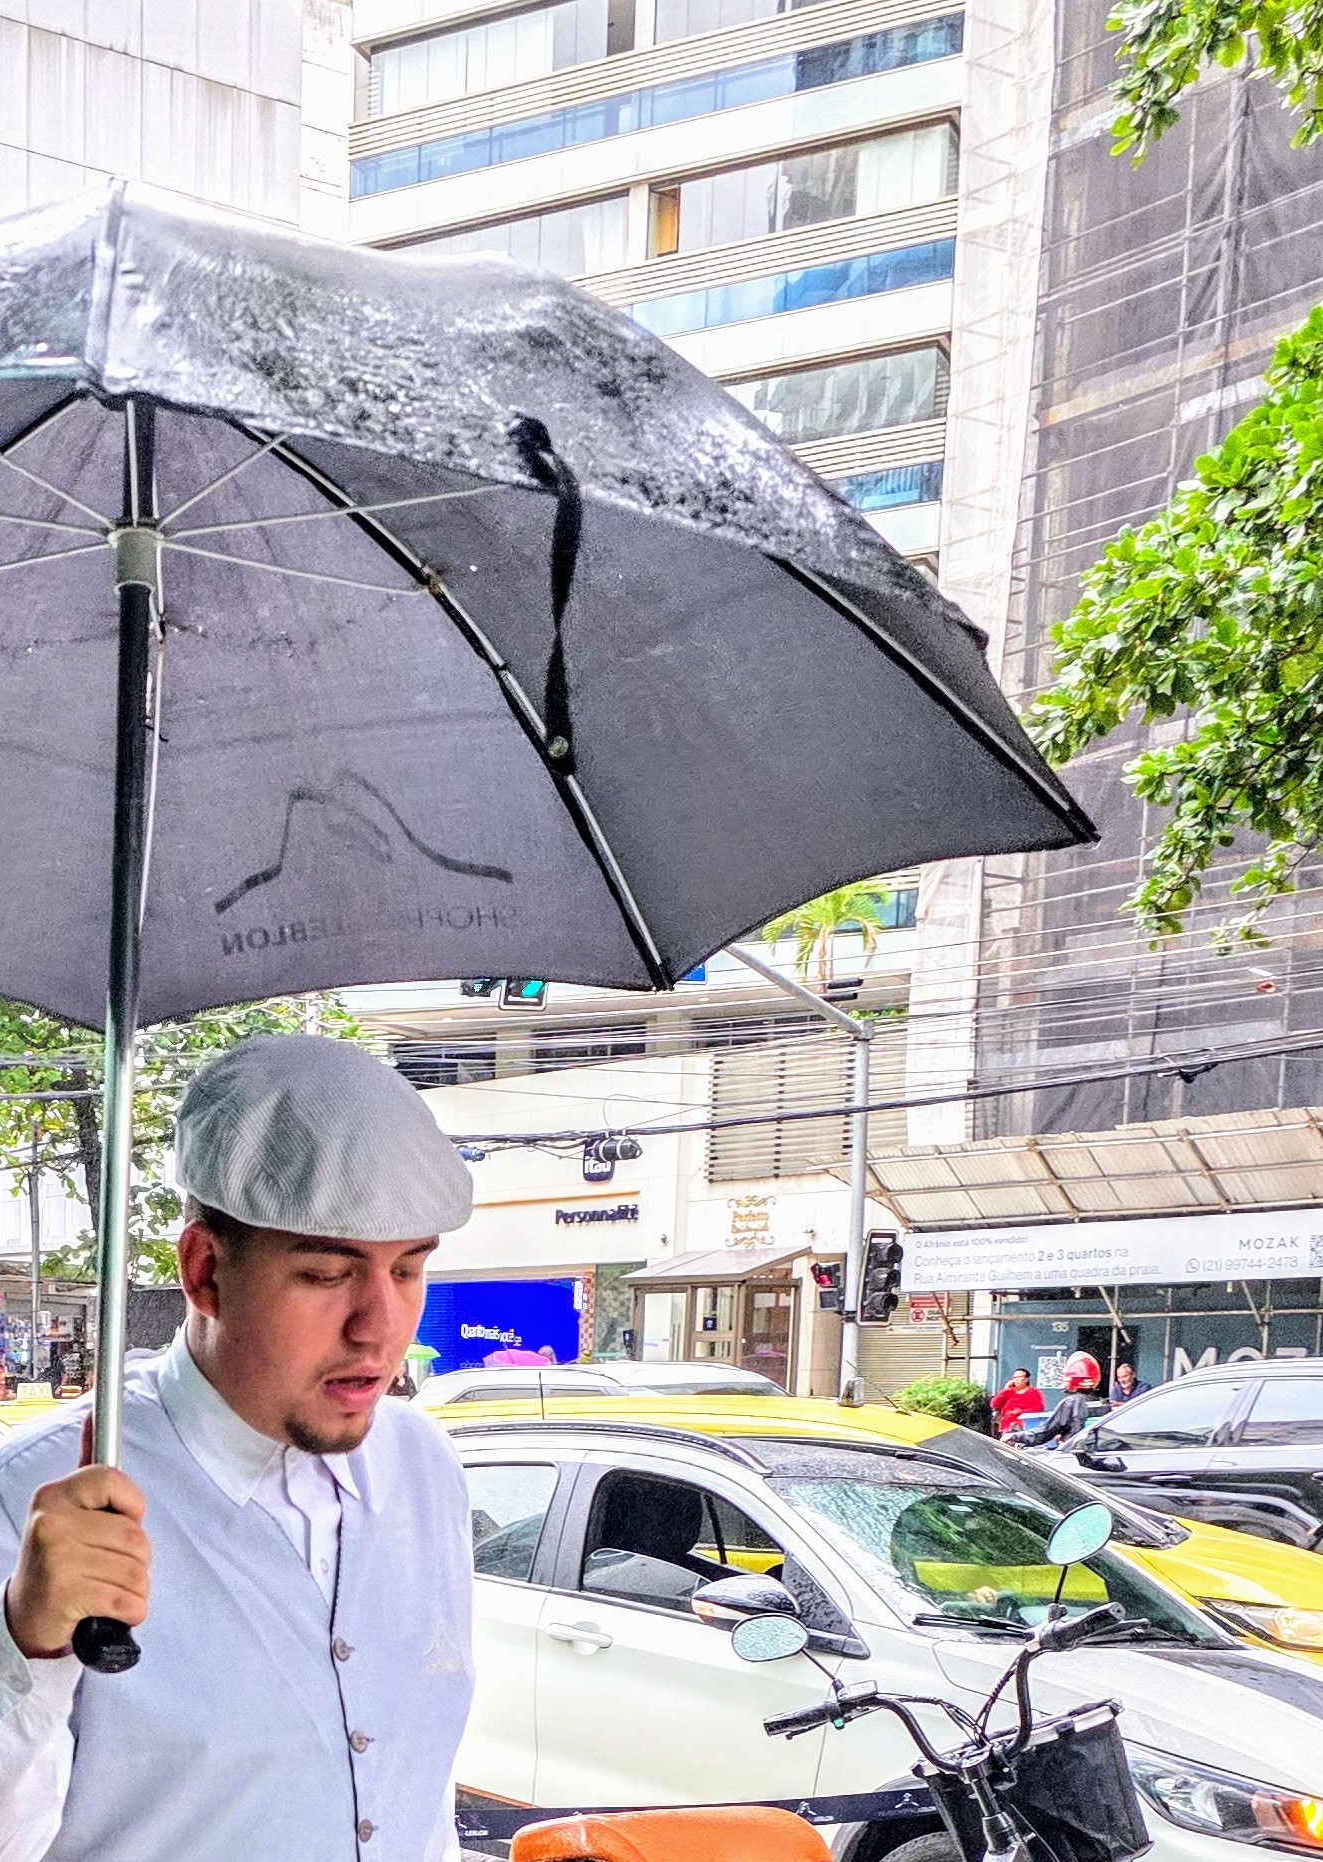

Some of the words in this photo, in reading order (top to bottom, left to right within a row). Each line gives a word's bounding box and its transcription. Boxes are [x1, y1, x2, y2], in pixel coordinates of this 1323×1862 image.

[555, 1204, 639, 1224] Personnalité
[971, 1236, 993, 1247] 100%
[1238, 1235, 1300, 1250] MOZAK
[914, 1254, 961, 1269] Conheça
[963, 1256, 971, 1265] o
[972, 1251, 1036, 1266] lançamento
[1037, 1250, 1045, 1262] 2
[1047, 1252, 1055, 1261] e
[1056, 1249, 1065, 1261] 3
[1066, 1247, 1112, 1262] quartos
[1114, 1249, 1129, 1258] na
[1202, 1258, 1223, 1273] (21)
[1224, 1256, 1299, 1271] 99744-2478
[913, 1272, 934, 1285] Rua
[935, 1271, 986, 1284] Almirante
[987, 1269, 1033, 1282] Guilhem
[1035, 1271, 1042, 1280] a
[1042, 1270, 1067, 1280] uma
[1069, 1265, 1110, 1281] quadra
[1111, 1264, 1127, 1276] da
